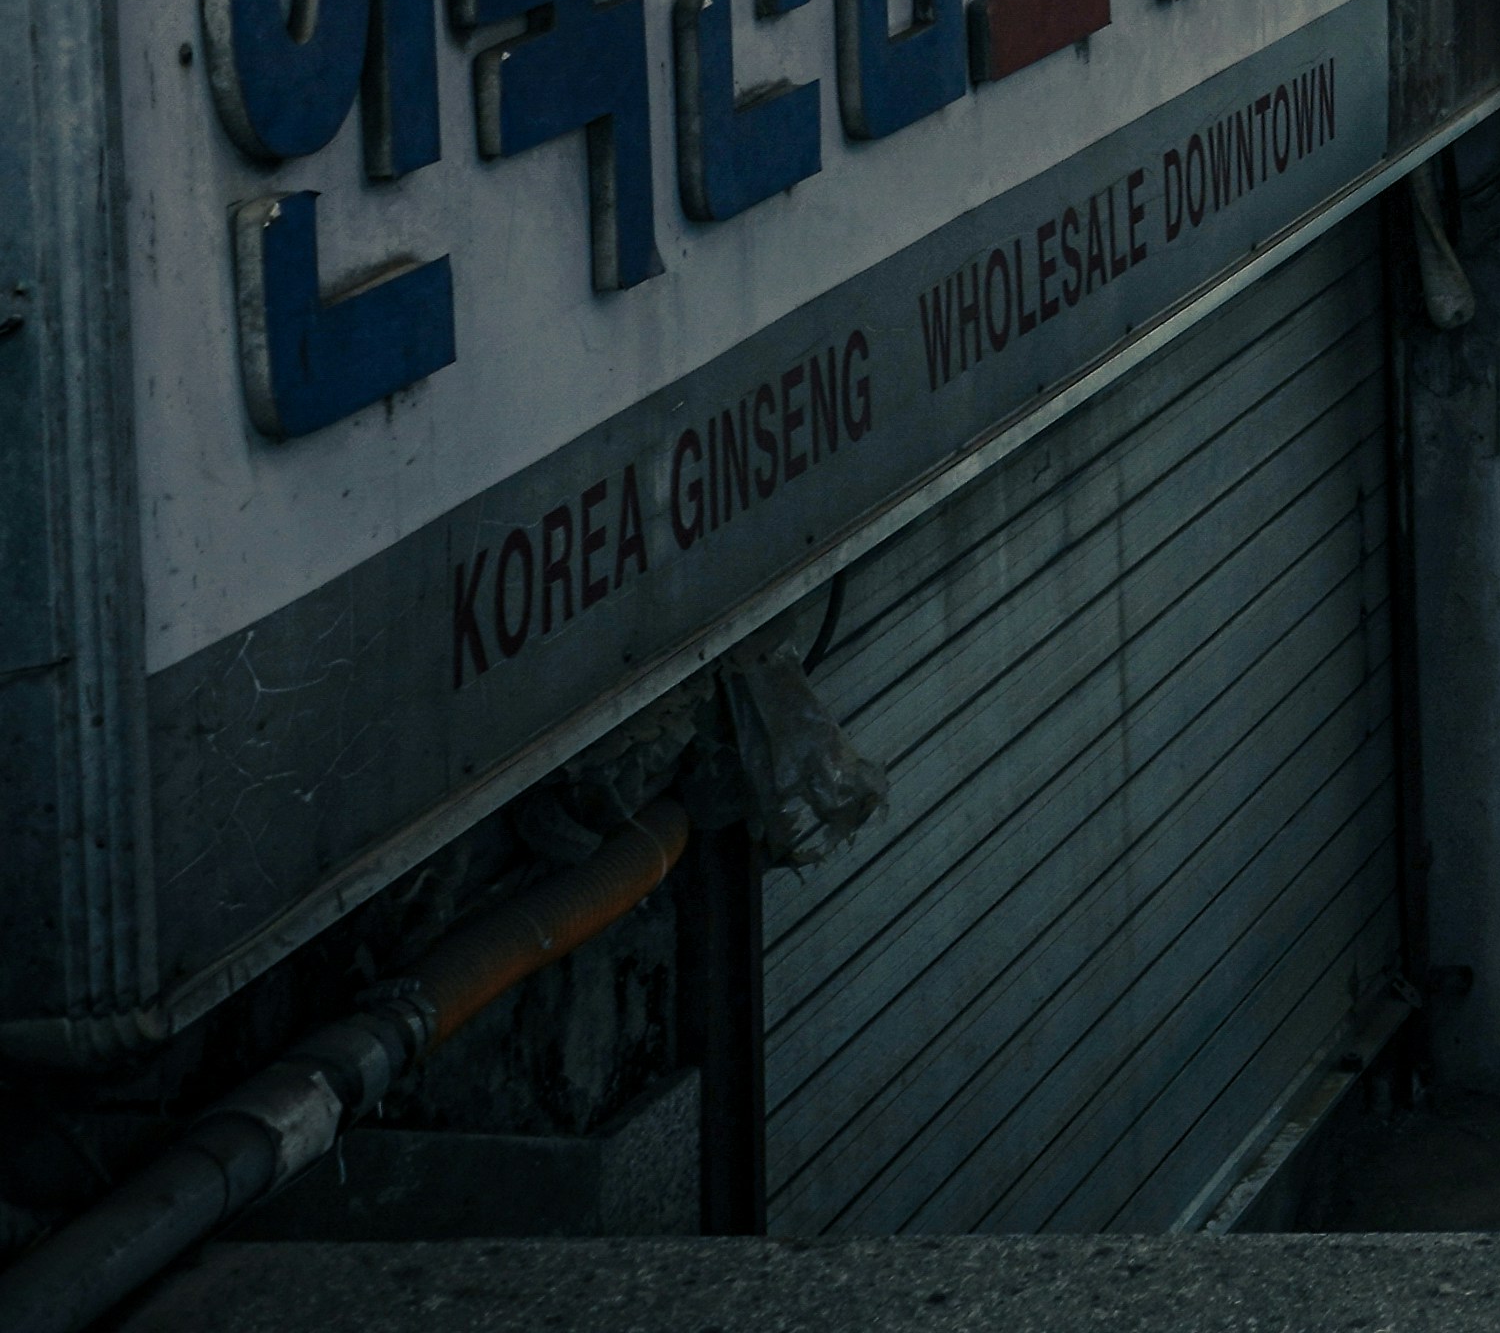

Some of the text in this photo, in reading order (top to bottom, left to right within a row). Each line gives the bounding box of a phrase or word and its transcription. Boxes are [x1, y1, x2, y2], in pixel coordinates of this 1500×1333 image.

[450, 57, 1338, 690] KOREA GINSENG WHOLESALE DOWNTOWN
